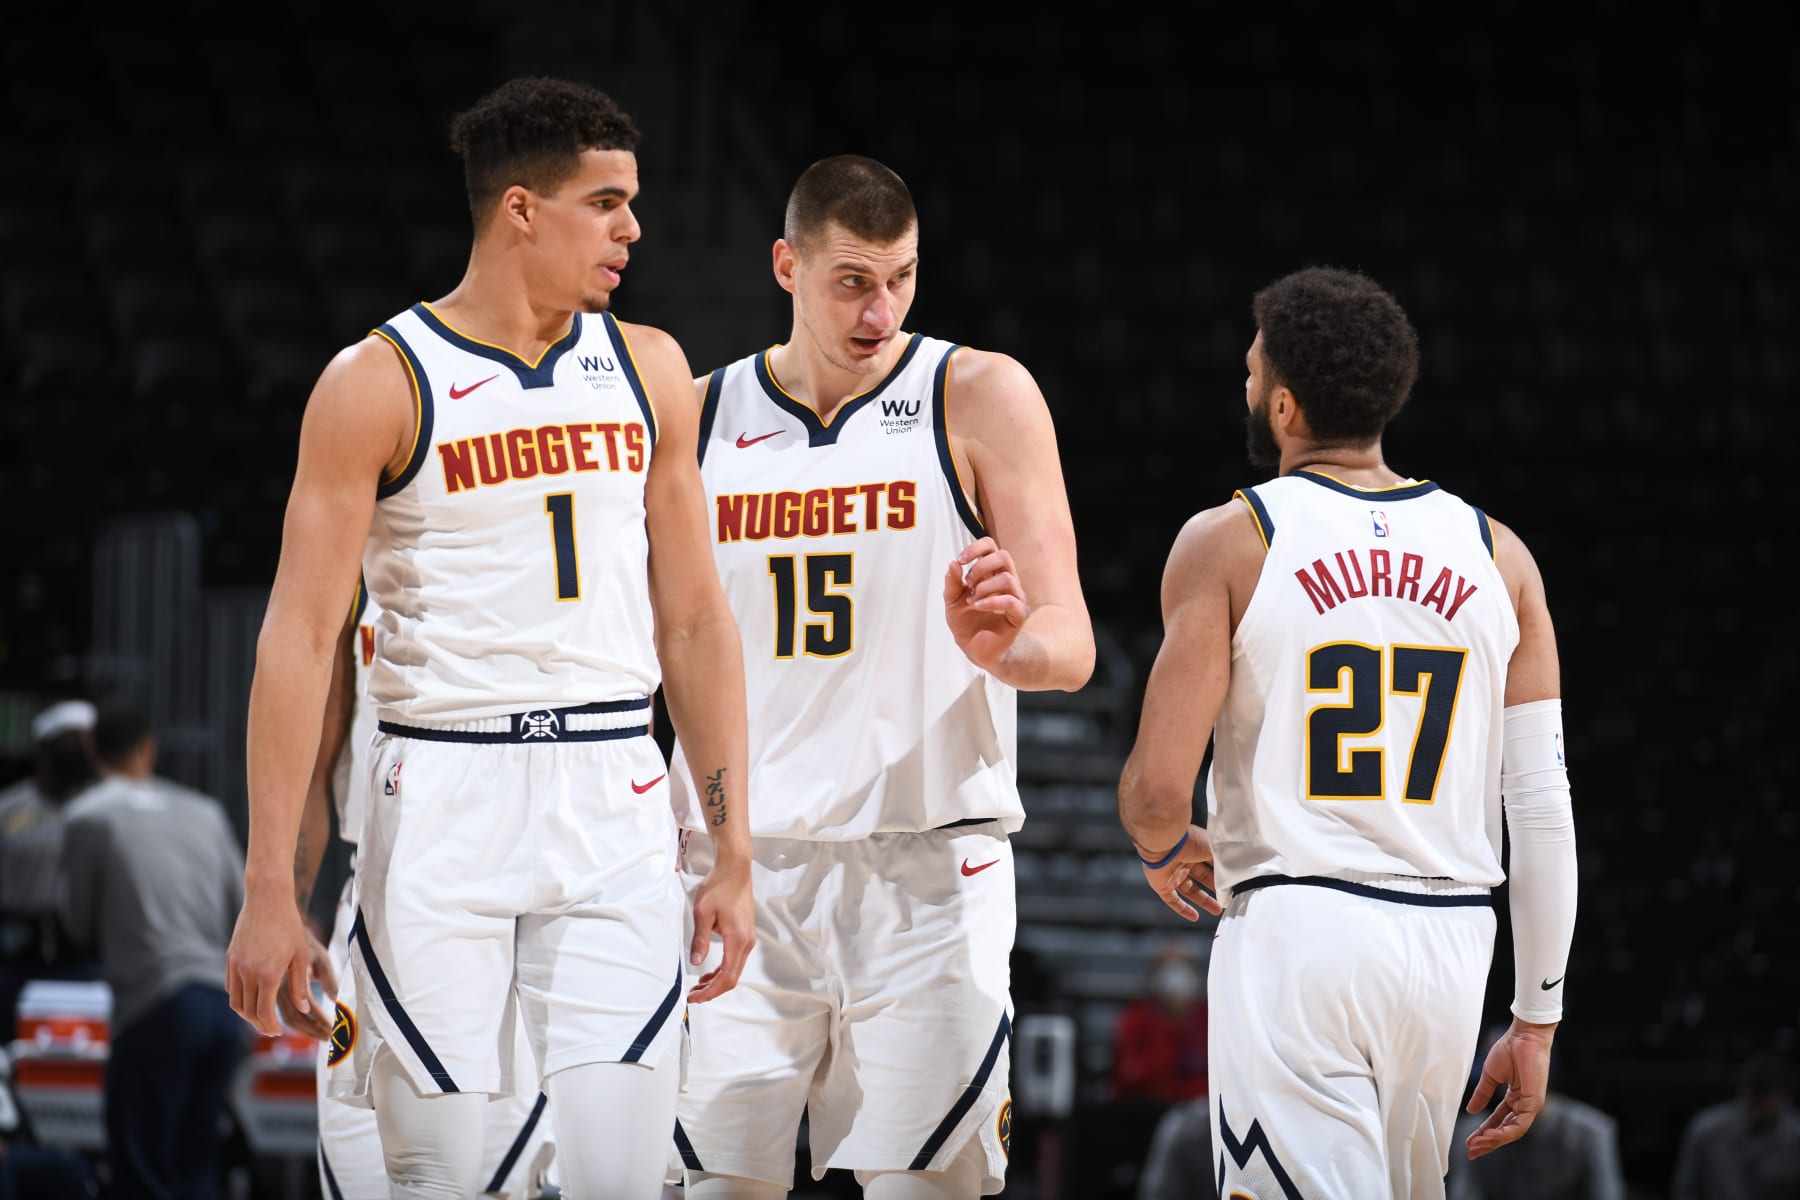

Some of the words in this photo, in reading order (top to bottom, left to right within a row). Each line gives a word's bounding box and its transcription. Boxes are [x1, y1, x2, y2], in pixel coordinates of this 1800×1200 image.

[577, 356, 615, 371] WU
[880, 418, 919, 427] Western
[881, 400, 921, 417] WU
[886, 427, 912, 435] Union
[437, 422, 644, 494] NUGGETS
[543, 491, 581, 601] 1
[716, 480, 917, 544] NUGGETS
[767, 552, 854, 659] 15
[1294, 549, 1478, 622] MURRAY
[1306, 640, 1470, 805] 27
